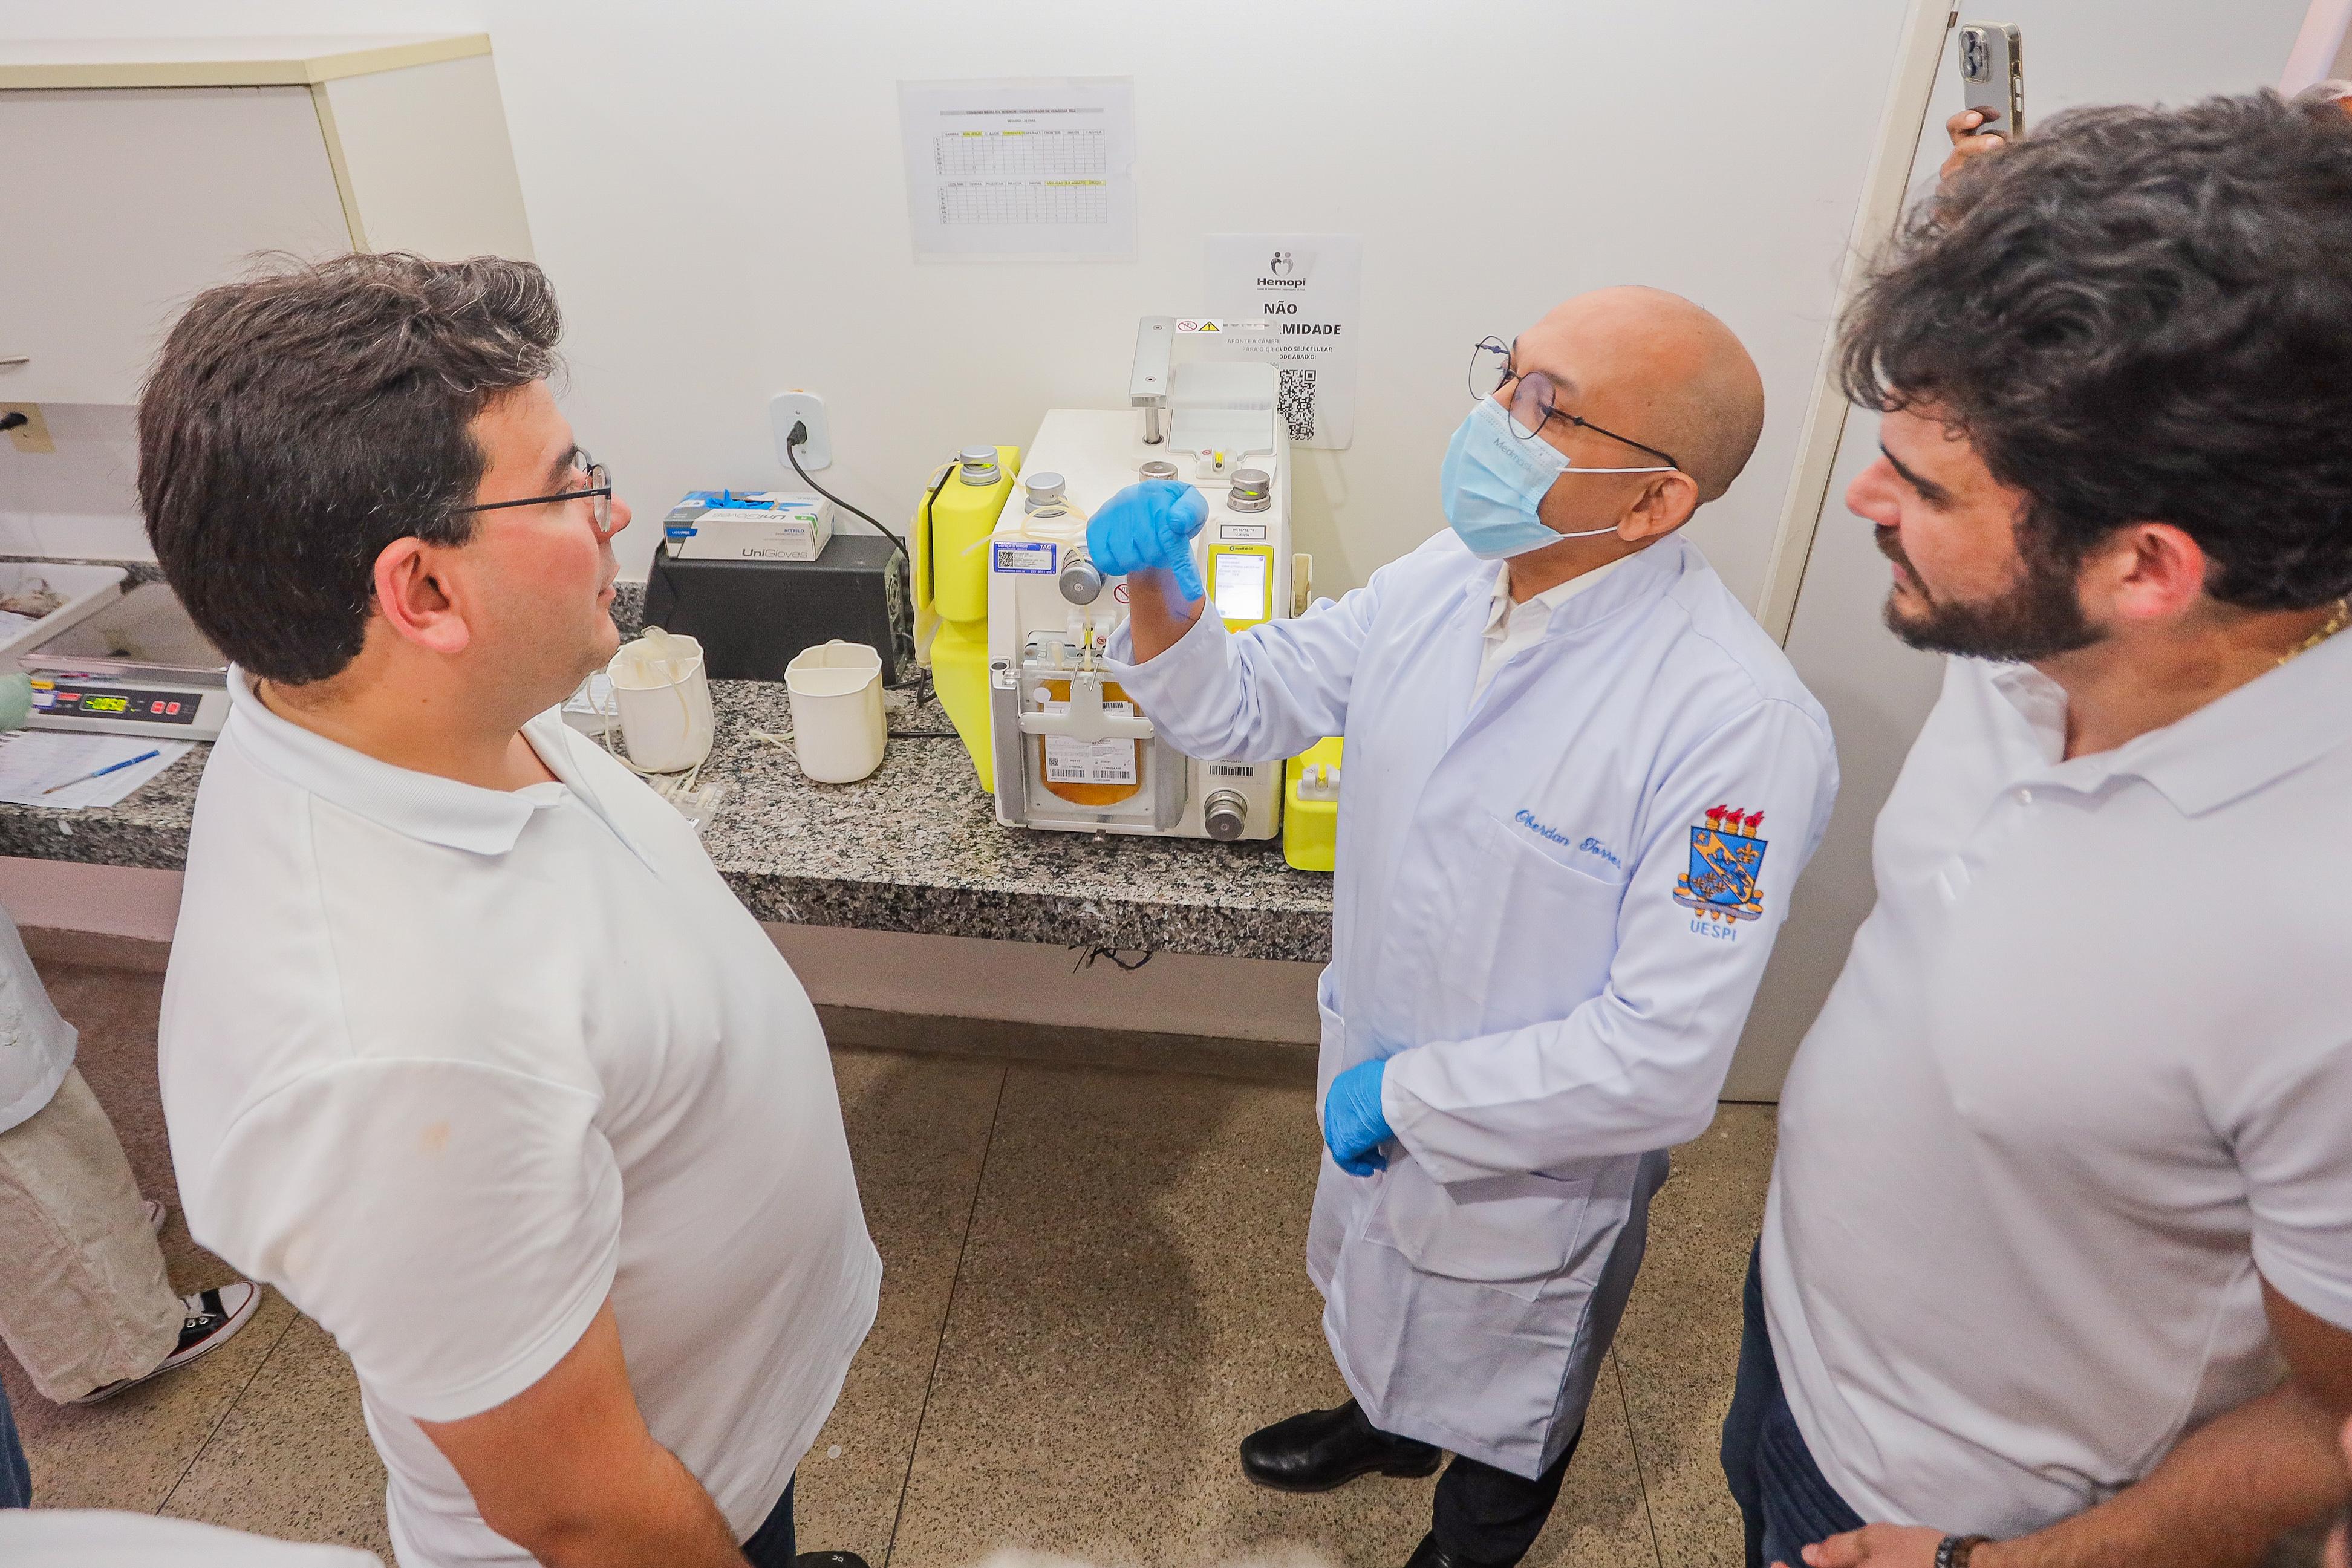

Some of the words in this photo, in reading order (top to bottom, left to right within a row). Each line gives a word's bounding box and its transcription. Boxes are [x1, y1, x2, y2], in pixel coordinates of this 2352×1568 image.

[1257, 278, 1306, 288] Hemopi
[1264, 300, 1298, 314] NÃO
[1279, 324, 1341, 335] MIDADE
[742, 548, 808, 558] UniGloves
[1515, 809, 1571, 847] Oberdan
[1690, 919, 1737, 942] UESPI
